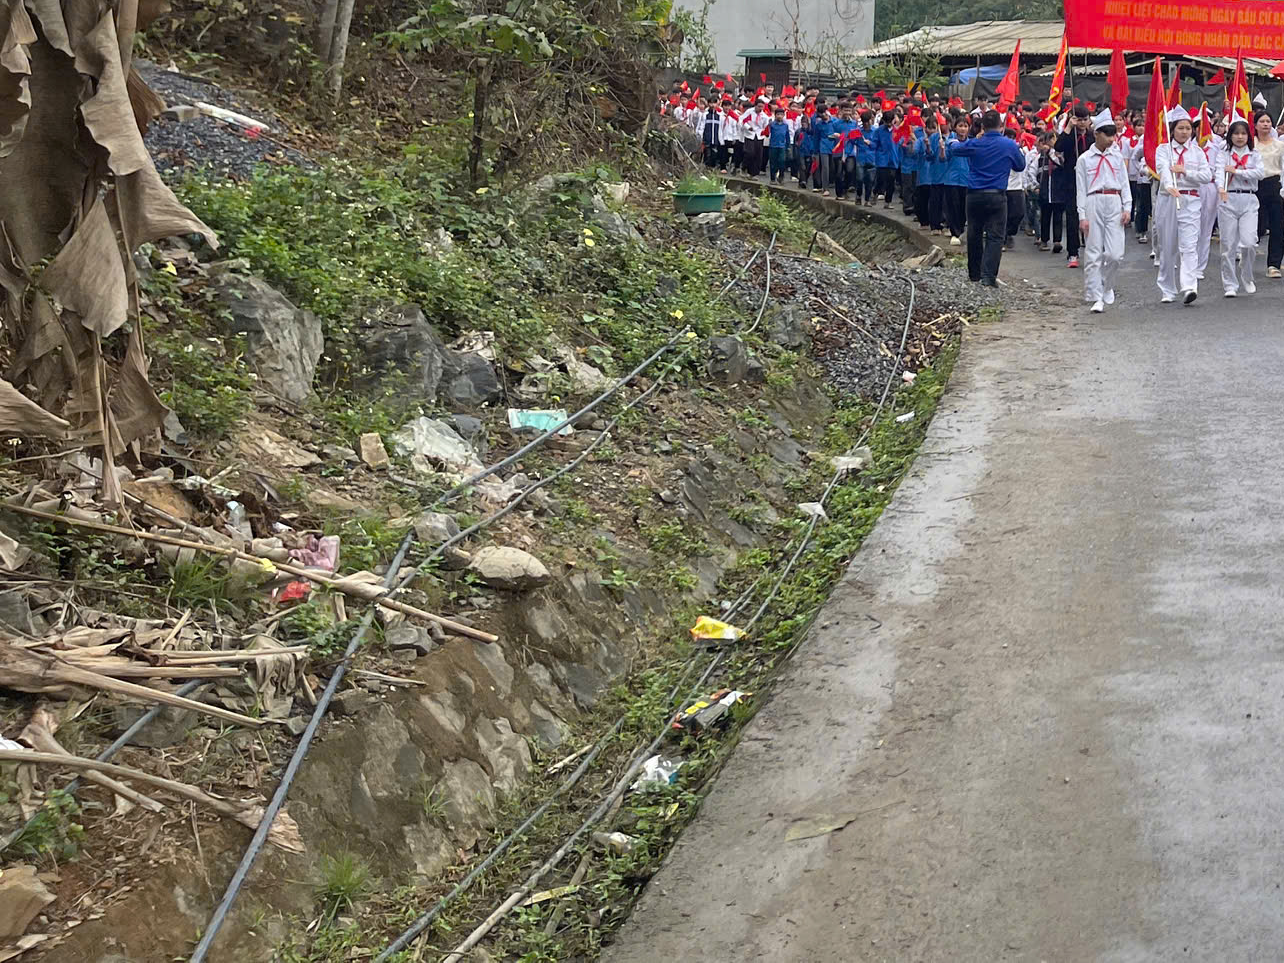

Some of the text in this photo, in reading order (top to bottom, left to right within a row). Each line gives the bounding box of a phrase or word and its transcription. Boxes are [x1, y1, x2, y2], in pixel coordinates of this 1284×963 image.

[1203, 29, 1230, 47] NHÂN
[1231, 31, 1252, 49] DÂN
[1253, 33, 1272, 49] CÁC
